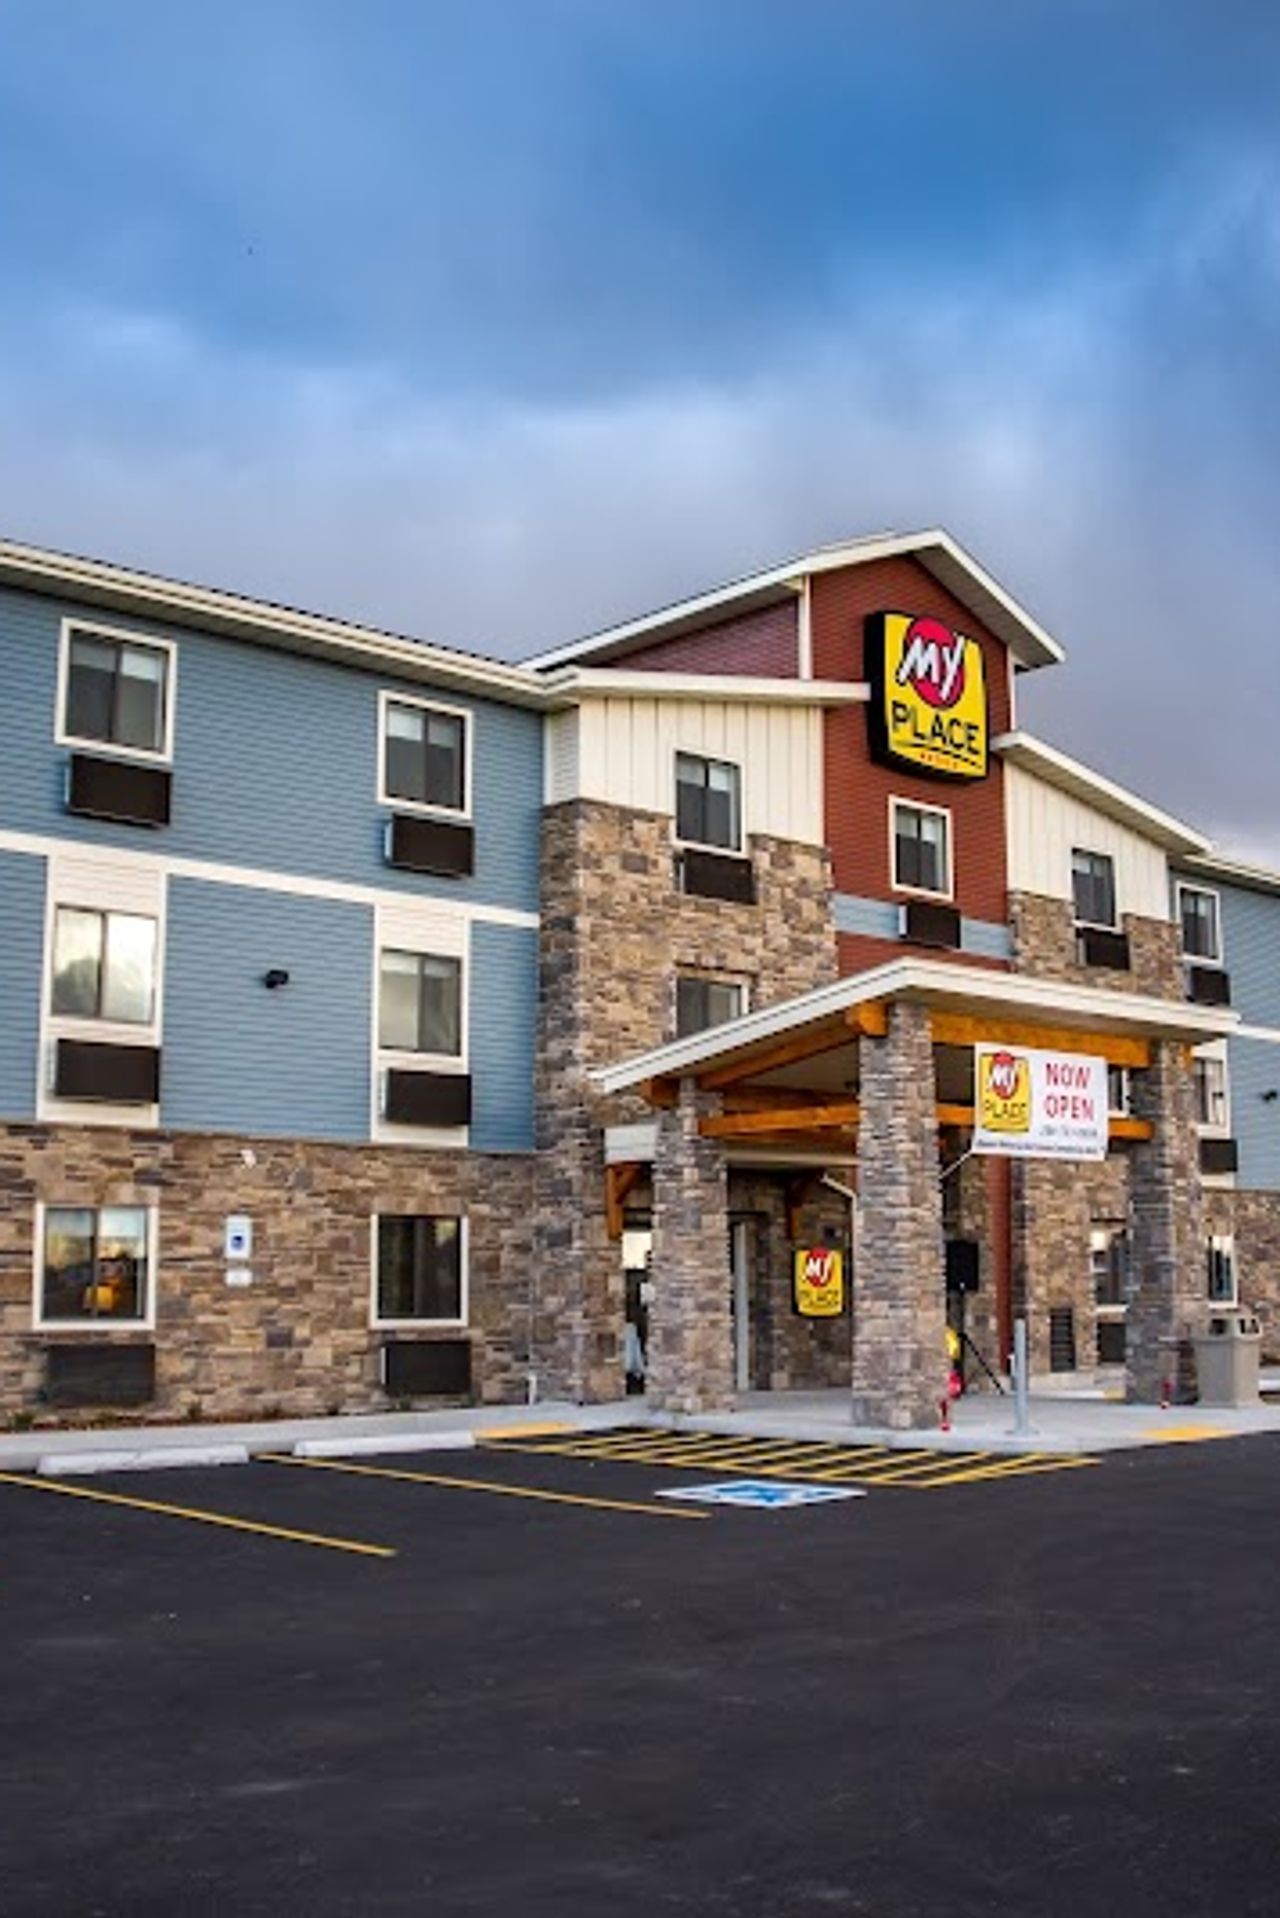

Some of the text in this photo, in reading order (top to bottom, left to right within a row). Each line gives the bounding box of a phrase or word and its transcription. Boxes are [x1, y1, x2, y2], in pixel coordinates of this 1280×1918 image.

[892, 700, 980, 756] PLACE
[1045, 1062, 1092, 1089] NOW
[984, 1099, 1027, 1119] PLACE
[1044, 1094, 1095, 1121] OPEN
